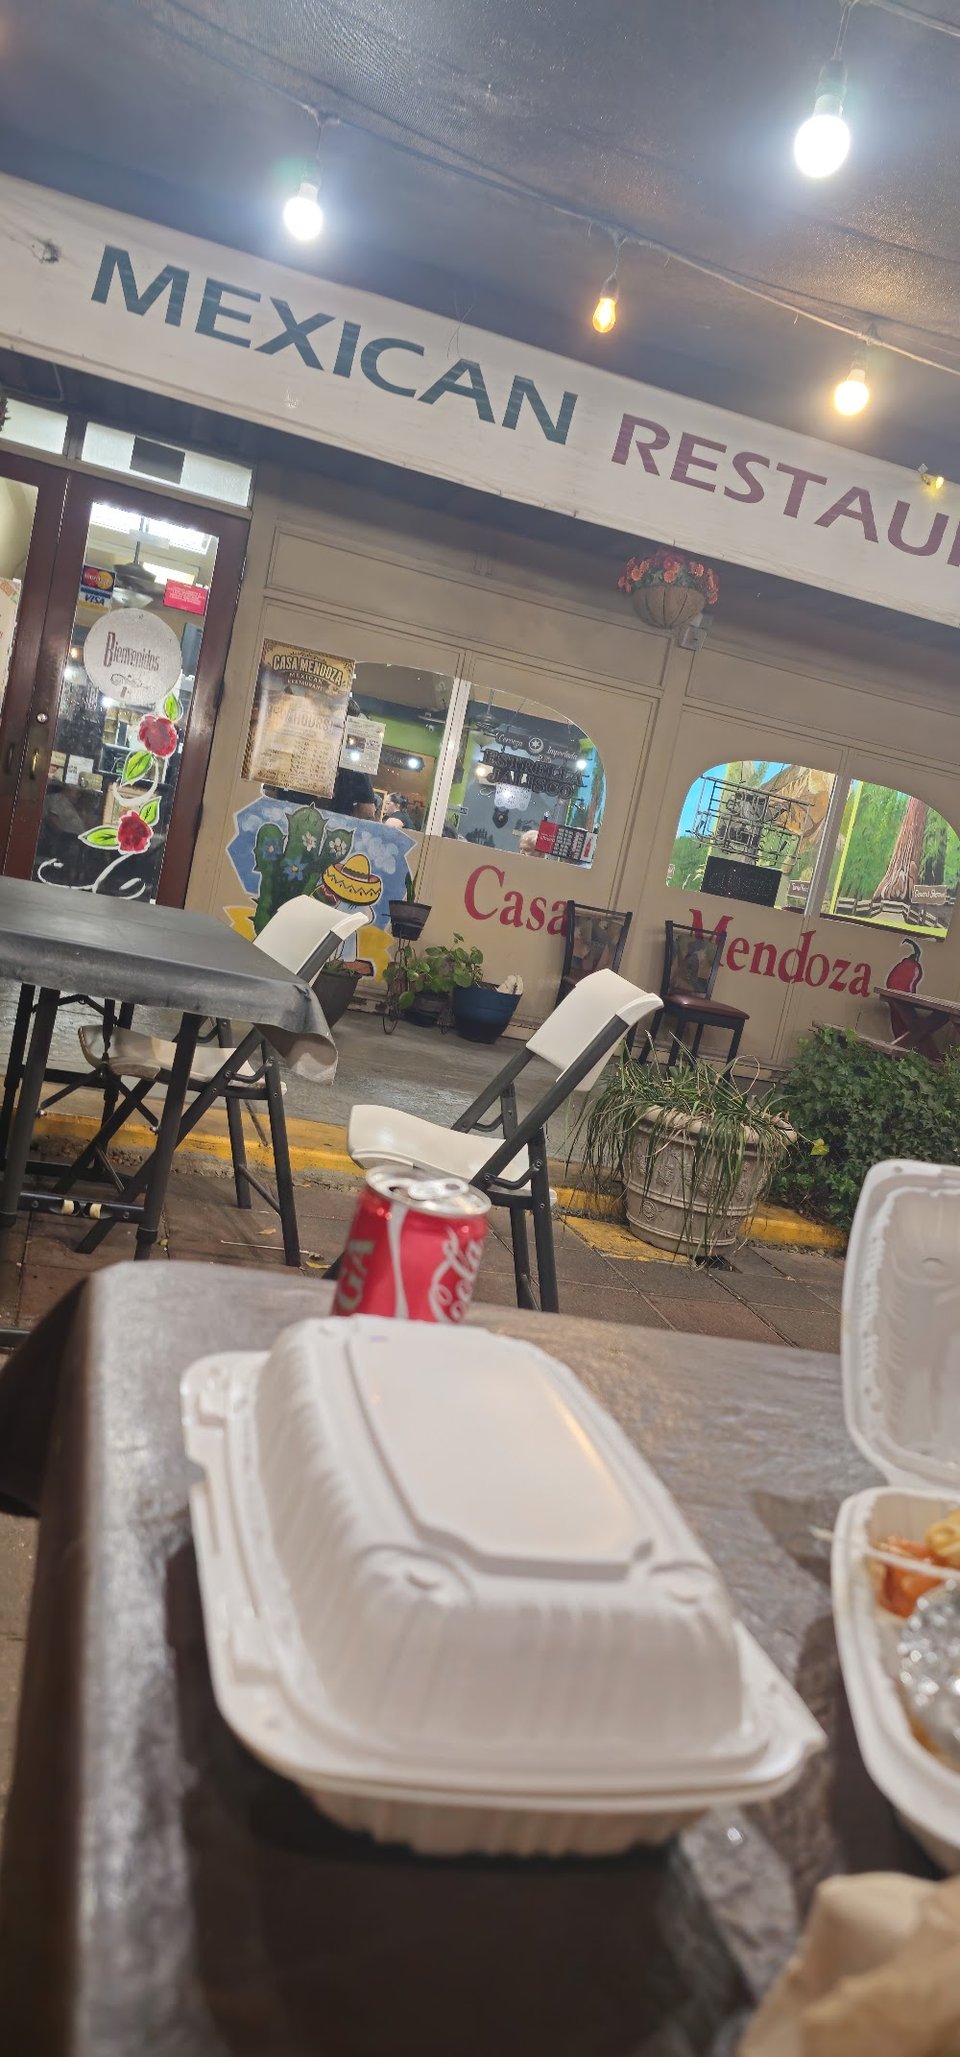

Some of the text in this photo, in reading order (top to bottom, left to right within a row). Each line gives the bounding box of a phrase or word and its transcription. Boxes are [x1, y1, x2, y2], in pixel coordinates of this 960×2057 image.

[91, 244, 960, 567] MEXICAN RESTAU
[85, 593, 105, 606] VISA
[103, 631, 160, 671] Bienvenidos
[273, 655, 298, 671] CASA
[299, 658, 343, 686] MENDOZA
[289, 672, 323, 684] MEXICAN
[484, 749, 584, 786] ESTRELLA
[487, 765, 573, 800] JALISCO
[464, 864, 570, 938] Casa
